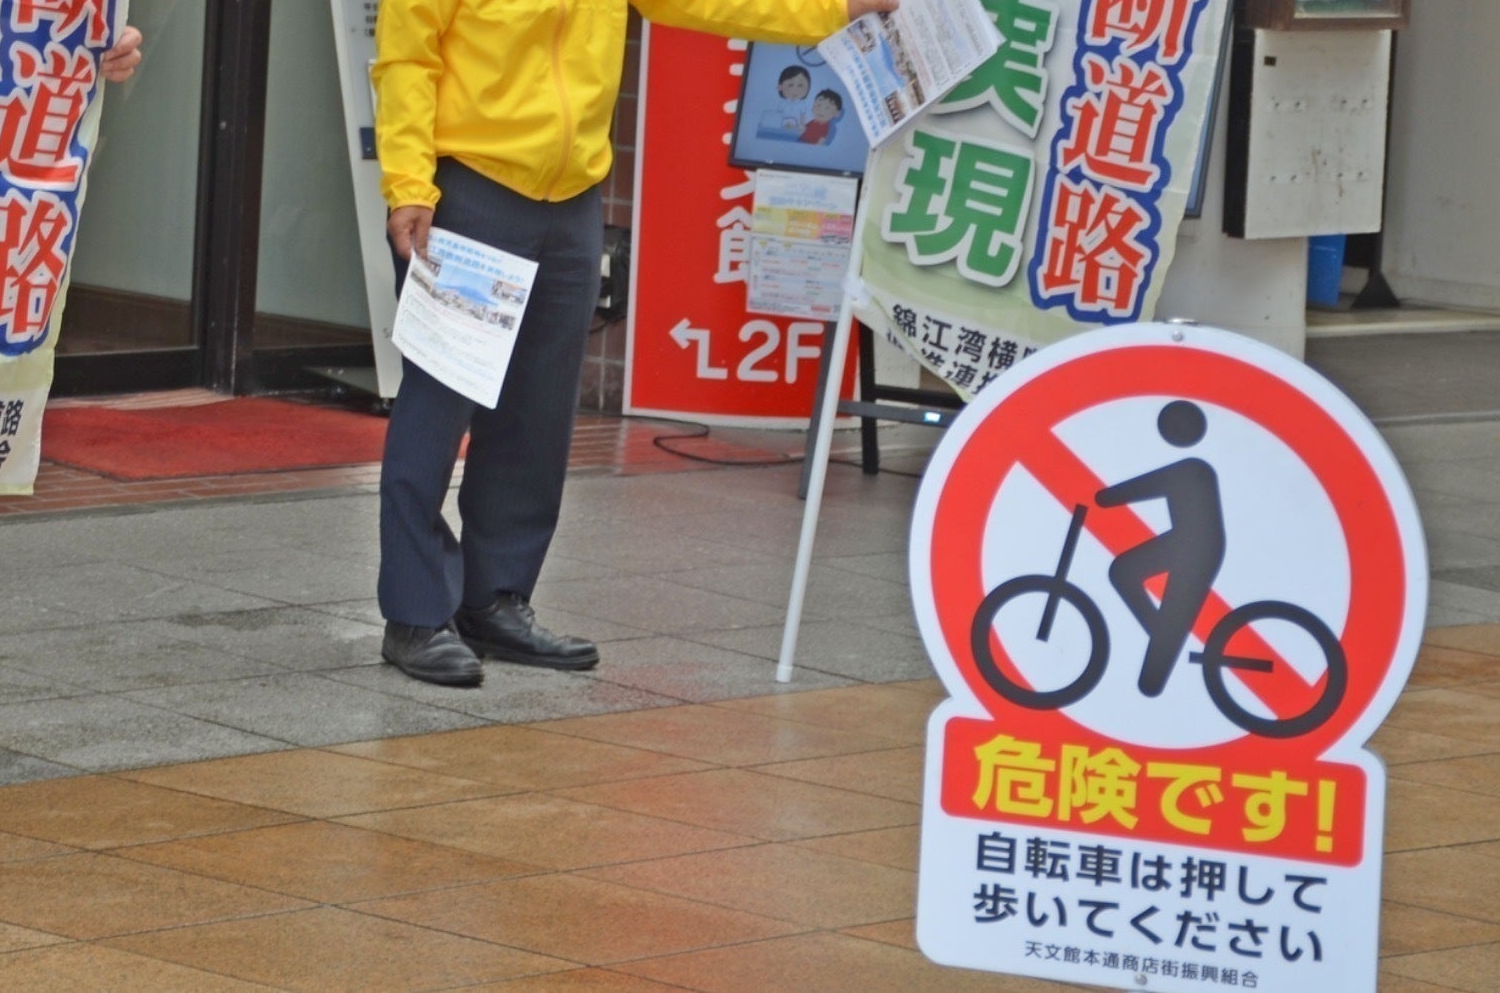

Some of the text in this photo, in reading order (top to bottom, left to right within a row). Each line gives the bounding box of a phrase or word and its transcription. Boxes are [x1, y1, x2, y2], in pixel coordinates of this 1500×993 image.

[736, 319, 824, 384] 2F
[972, 734, 1337, 854] 危険です!
[975, 831, 1329, 915] 自転車は押して
[972, 883, 1324, 964] 歩いてください
[1024, 940, 1260, 989] 天文館本通商店街振興組合
